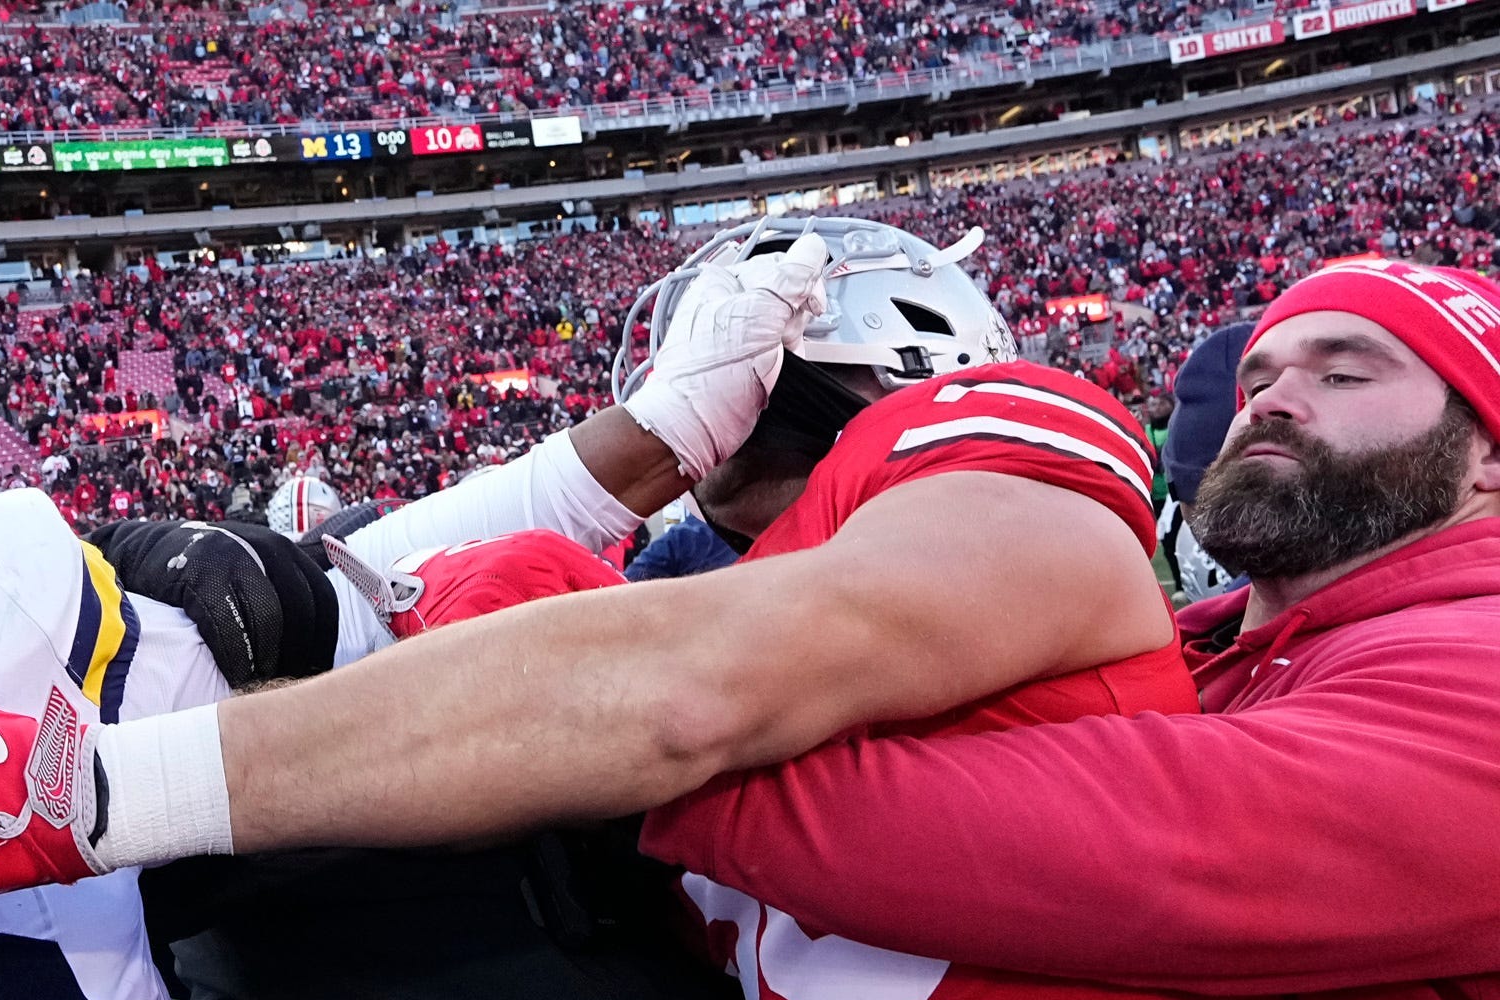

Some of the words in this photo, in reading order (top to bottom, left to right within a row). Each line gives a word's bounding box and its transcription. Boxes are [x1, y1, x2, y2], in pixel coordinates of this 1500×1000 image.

[1332, 0, 1413, 28] HORVATH
[1177, 41, 1198, 58] 10
[1211, 25, 1273, 53] SMITH
[301, 137, 328, 158] M
[333, 133, 362, 157] 13
[425, 128, 453, 151] 10
